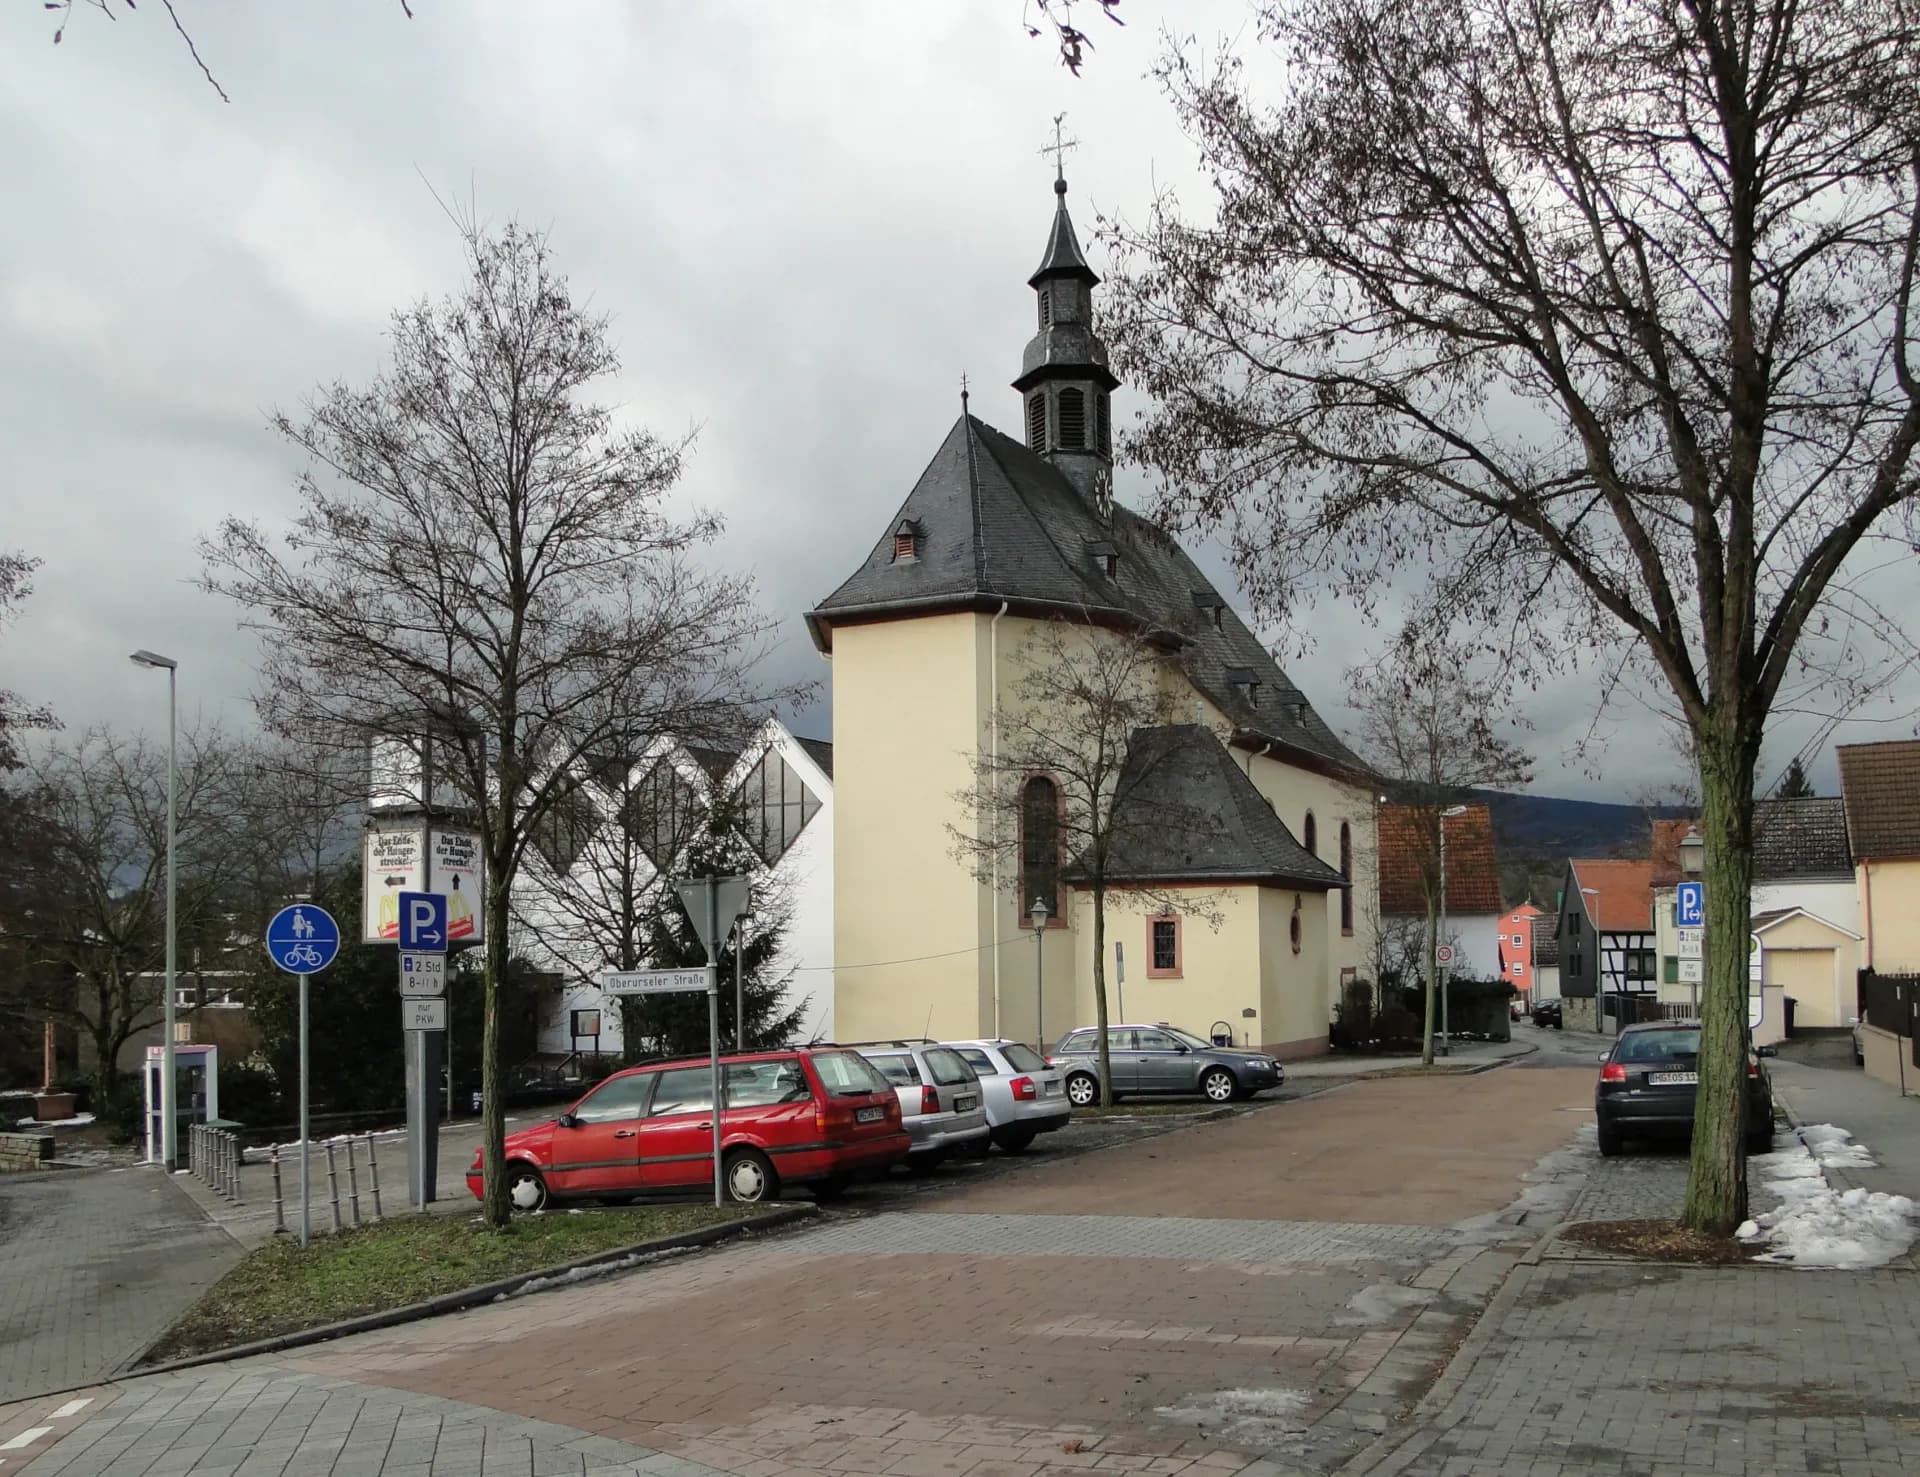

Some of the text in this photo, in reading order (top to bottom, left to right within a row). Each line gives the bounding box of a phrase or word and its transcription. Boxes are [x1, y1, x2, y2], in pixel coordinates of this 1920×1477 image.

[441, 835, 453, 845] Das
[373, 847, 385, 857] der
[436, 845, 448, 855] der
[1683, 888, 1696, 920] P
[410, 900, 436, 943] P
[415, 961, 441, 973] 2 Std
[610, 974, 704, 988] Oberurseler Straße
[417, 1004, 431, 1012] nur
[415, 1014, 434, 1025] PKW
